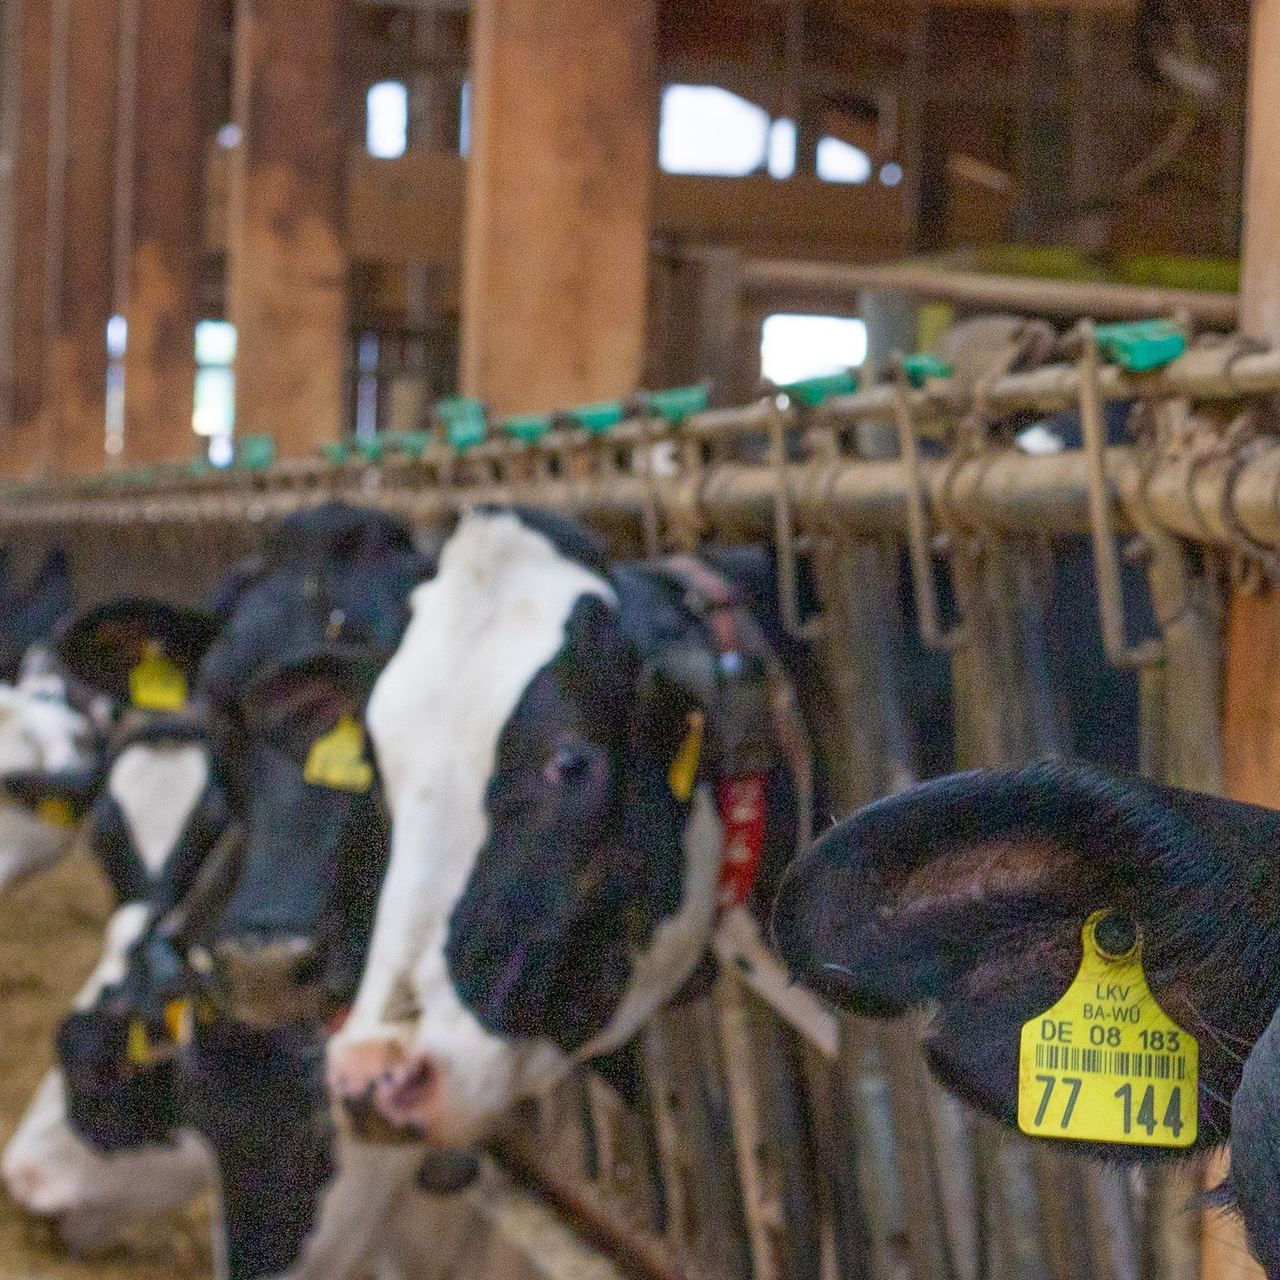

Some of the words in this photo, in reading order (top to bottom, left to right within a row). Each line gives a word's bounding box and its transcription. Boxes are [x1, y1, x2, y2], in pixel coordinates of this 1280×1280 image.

[1096, 984, 1130, 1001] LKV
[1083, 1003, 1141, 1024] BA-WÜ
[1041, 1019, 1073, 1043] DE
[1090, 1025, 1121, 1047] 08
[1139, 1030, 1180, 1052] 183
[1034, 1074, 1083, 1129] 77
[1114, 1083, 1184, 1138] 144
